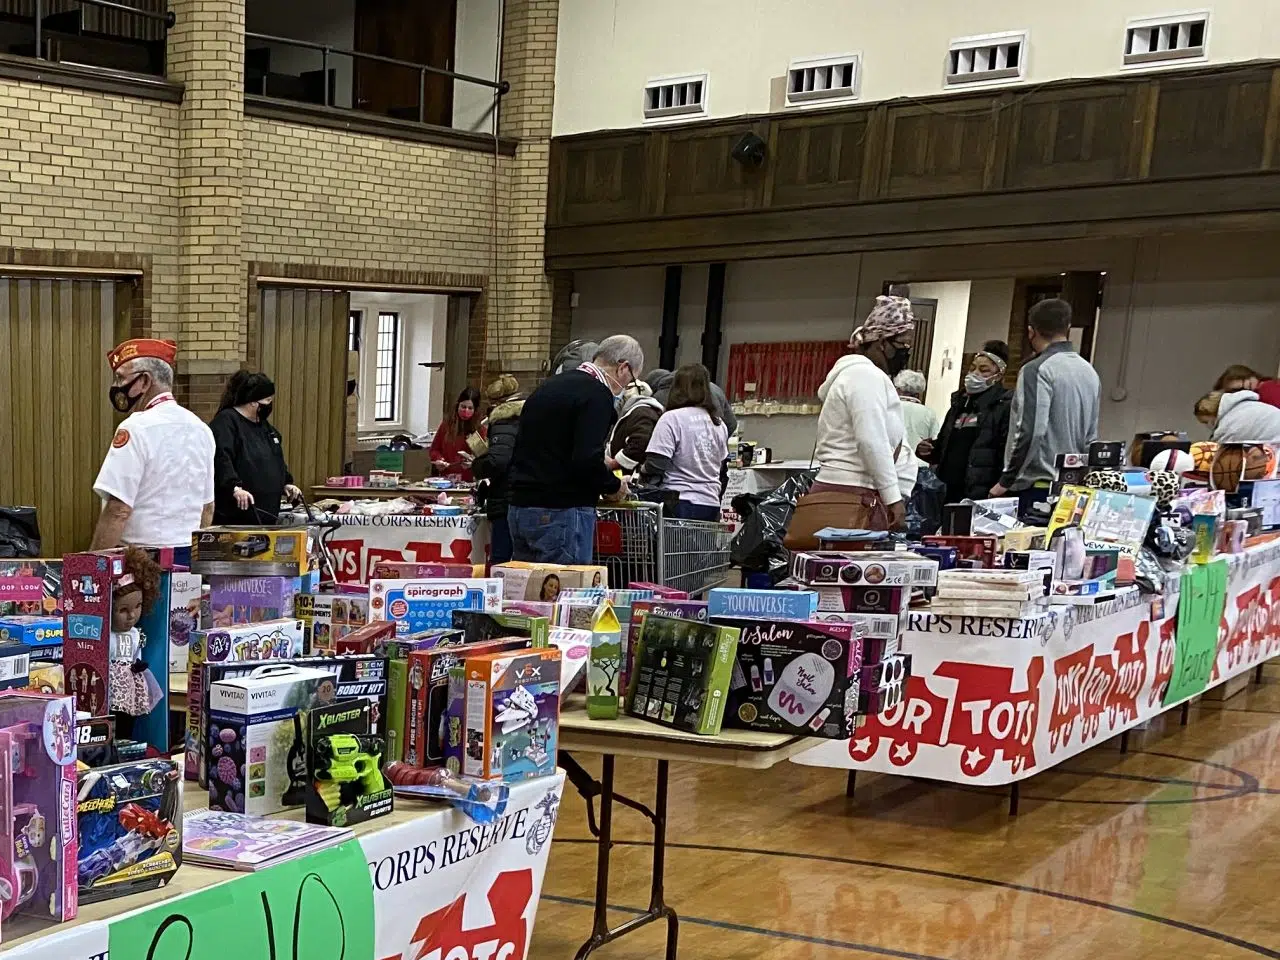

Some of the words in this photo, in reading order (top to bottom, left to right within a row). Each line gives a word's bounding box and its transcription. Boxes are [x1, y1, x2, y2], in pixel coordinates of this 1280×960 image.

[372, 516, 412, 527] CORPS
[414, 516, 468, 528] RESERVE
[72, 576, 100, 594] PLAY
[407, 586, 463, 598] spirograph
[74, 622, 100, 638] Girls
[751, 624, 794, 645] Salon
[906, 614, 952, 634] RPS
[960, 617, 1044, 639] RESERVE
[77, 642, 94, 651] Mira
[1177, 641, 1211, 692] Years
[220, 690, 245, 700] VIVITAR
[250, 688, 276, 700] VIVITAR
[336, 684, 368, 695] ROBOT
[368, 682, 384, 692] KIT
[318, 708, 362, 729] XBLASTER
[877, 698, 932, 734] OR
[962, 700, 1035, 746] TOTS
[440, 808, 529, 868] RESERVE
